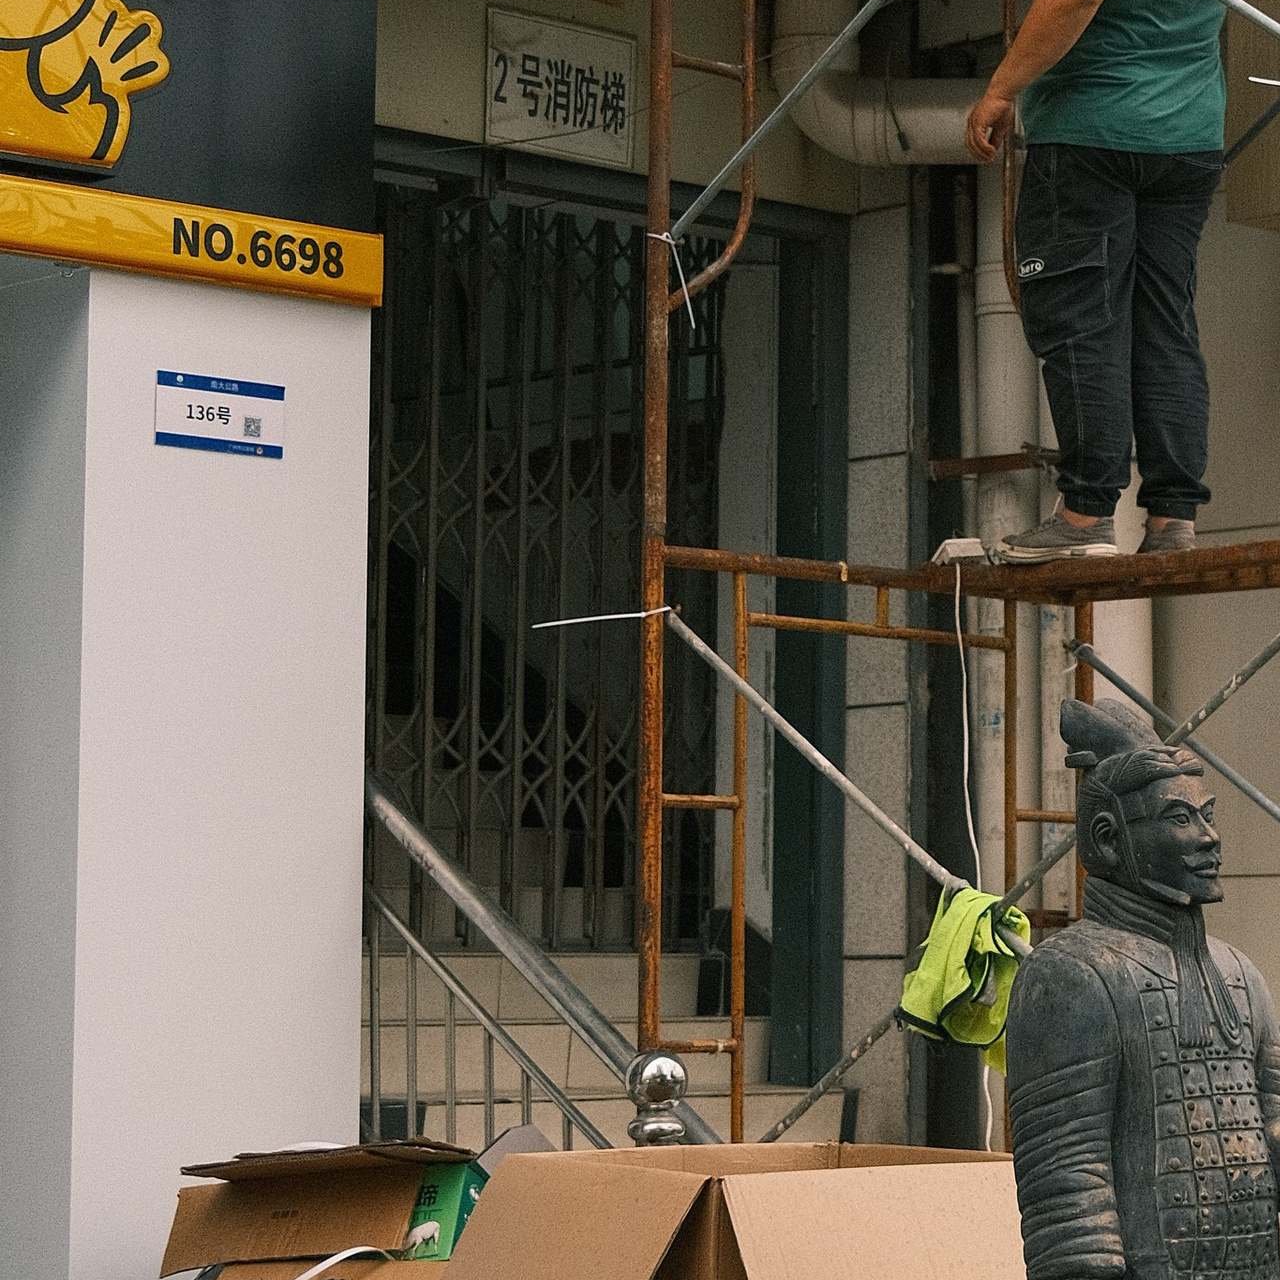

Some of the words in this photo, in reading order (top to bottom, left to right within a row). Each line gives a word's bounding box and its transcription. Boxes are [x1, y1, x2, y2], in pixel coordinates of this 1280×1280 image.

[494, 52, 626, 135] 2号消防梯
[172, 217, 345, 279] NO.6698
[186, 404, 232, 425] 136号
